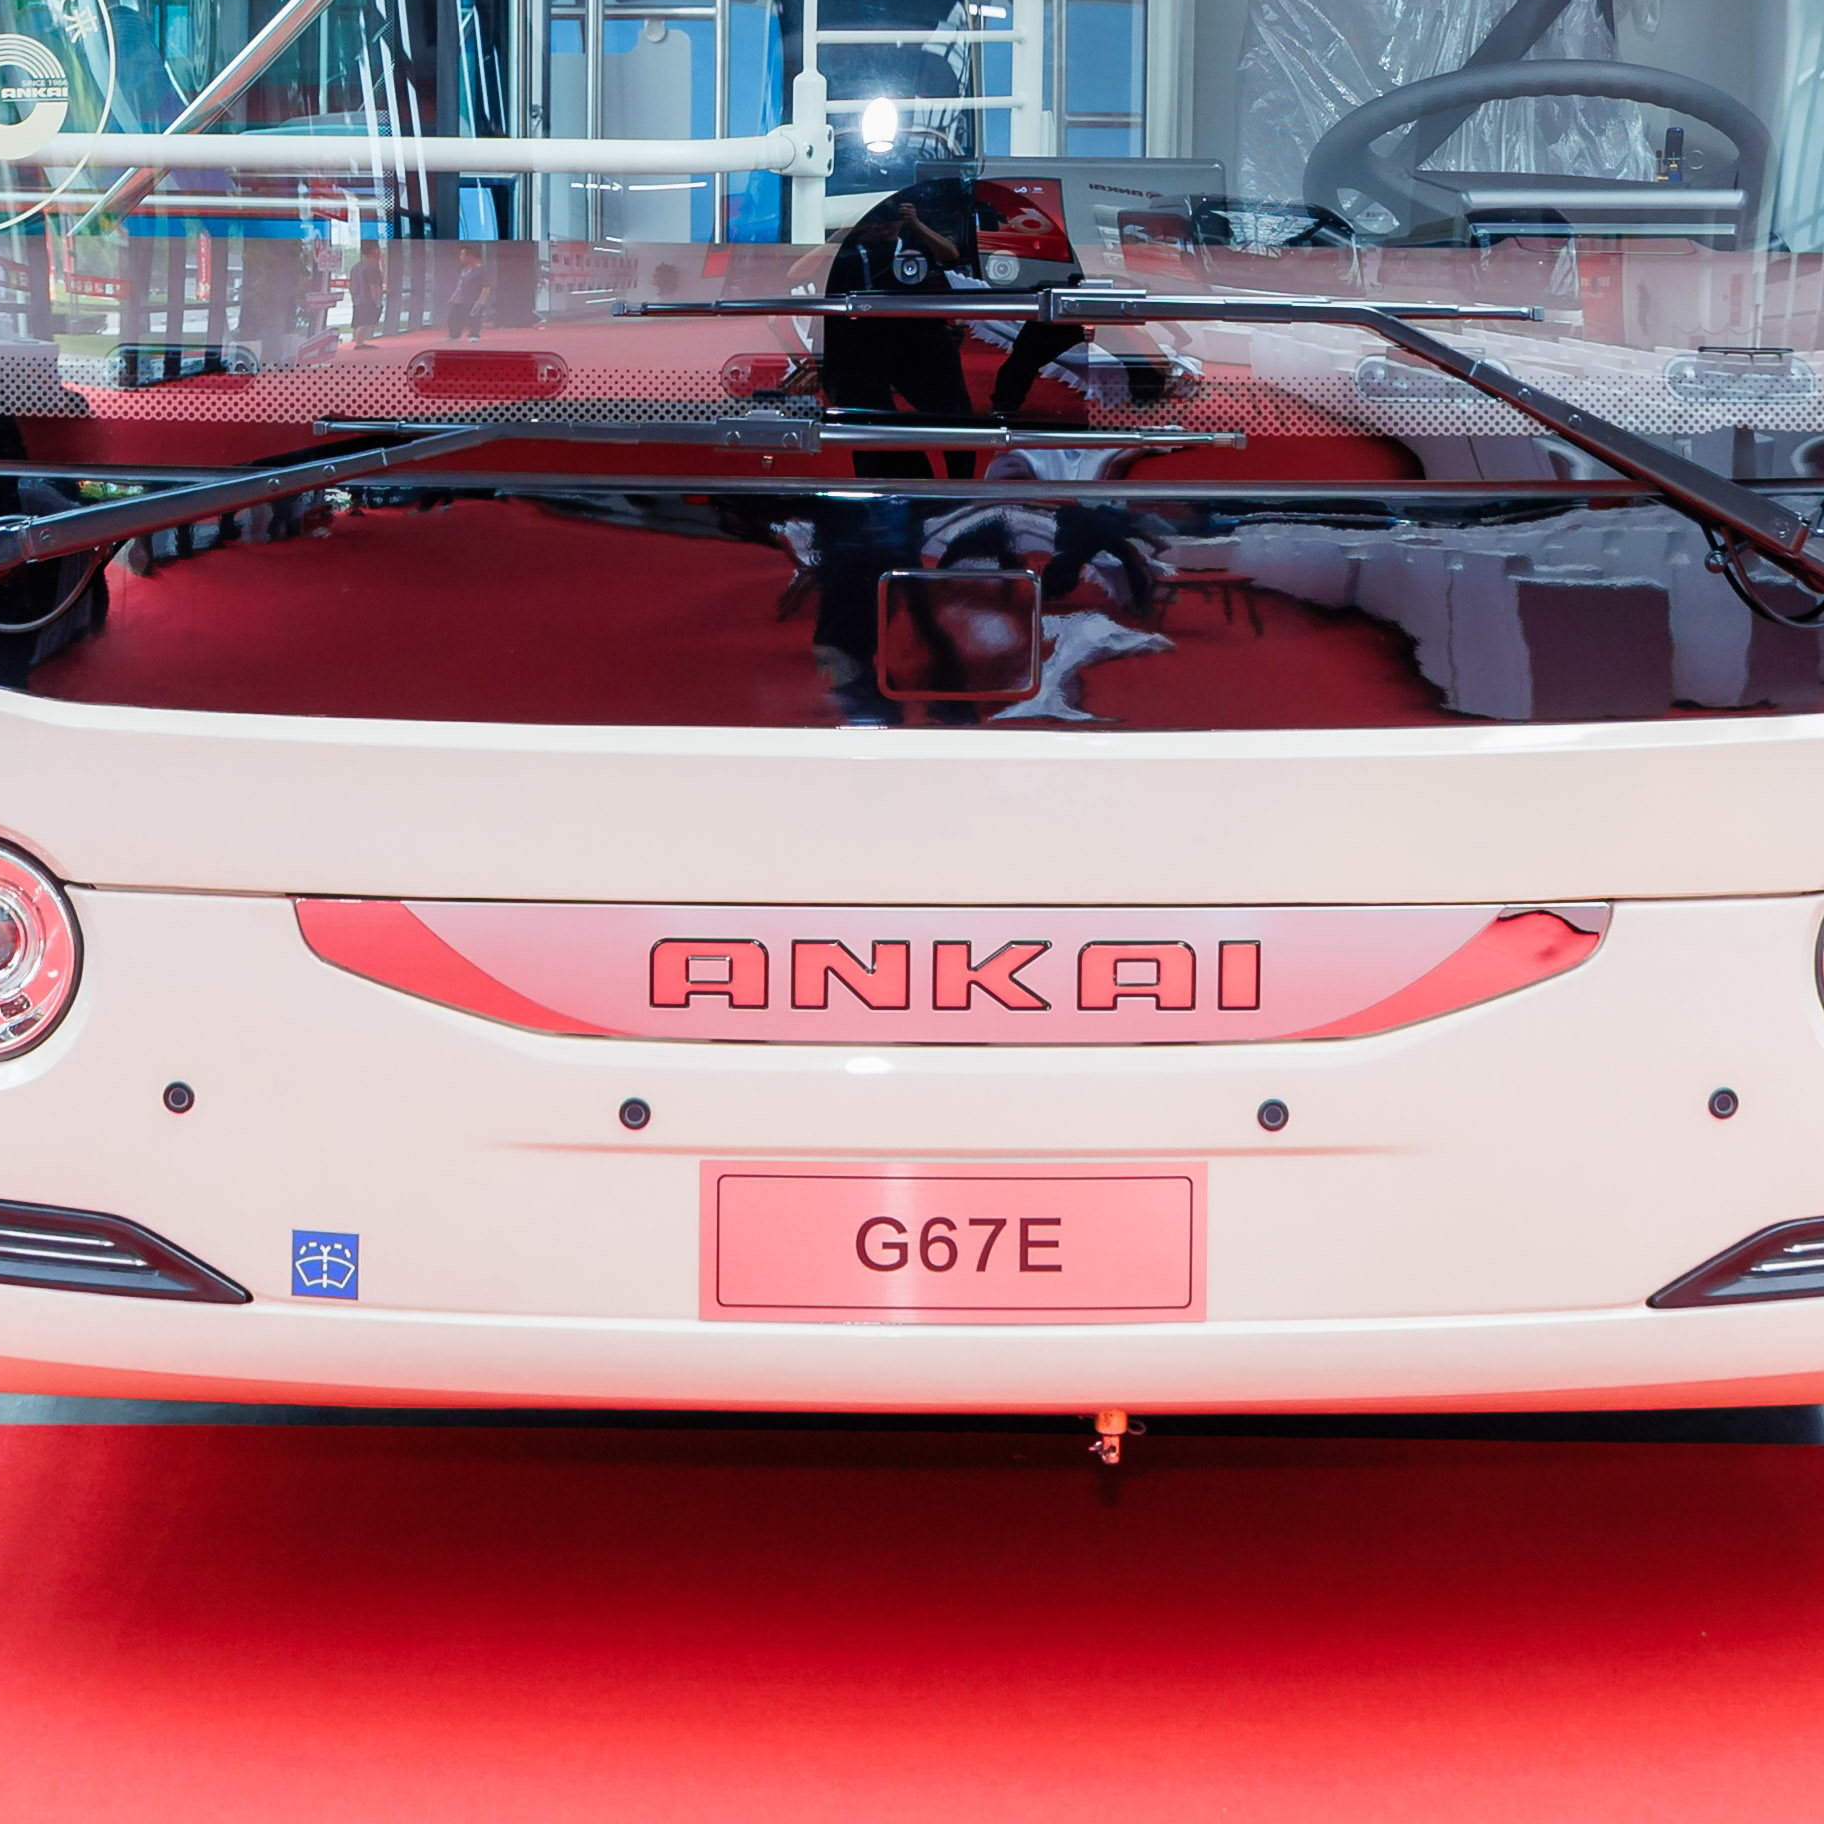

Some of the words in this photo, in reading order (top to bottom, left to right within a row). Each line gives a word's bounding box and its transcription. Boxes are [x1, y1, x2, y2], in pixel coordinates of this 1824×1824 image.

[1, 87, 68, 98] ANKAI
[649, 939, 1261, 1012] ANKAI
[855, 1216, 1063, 1274] G67E
